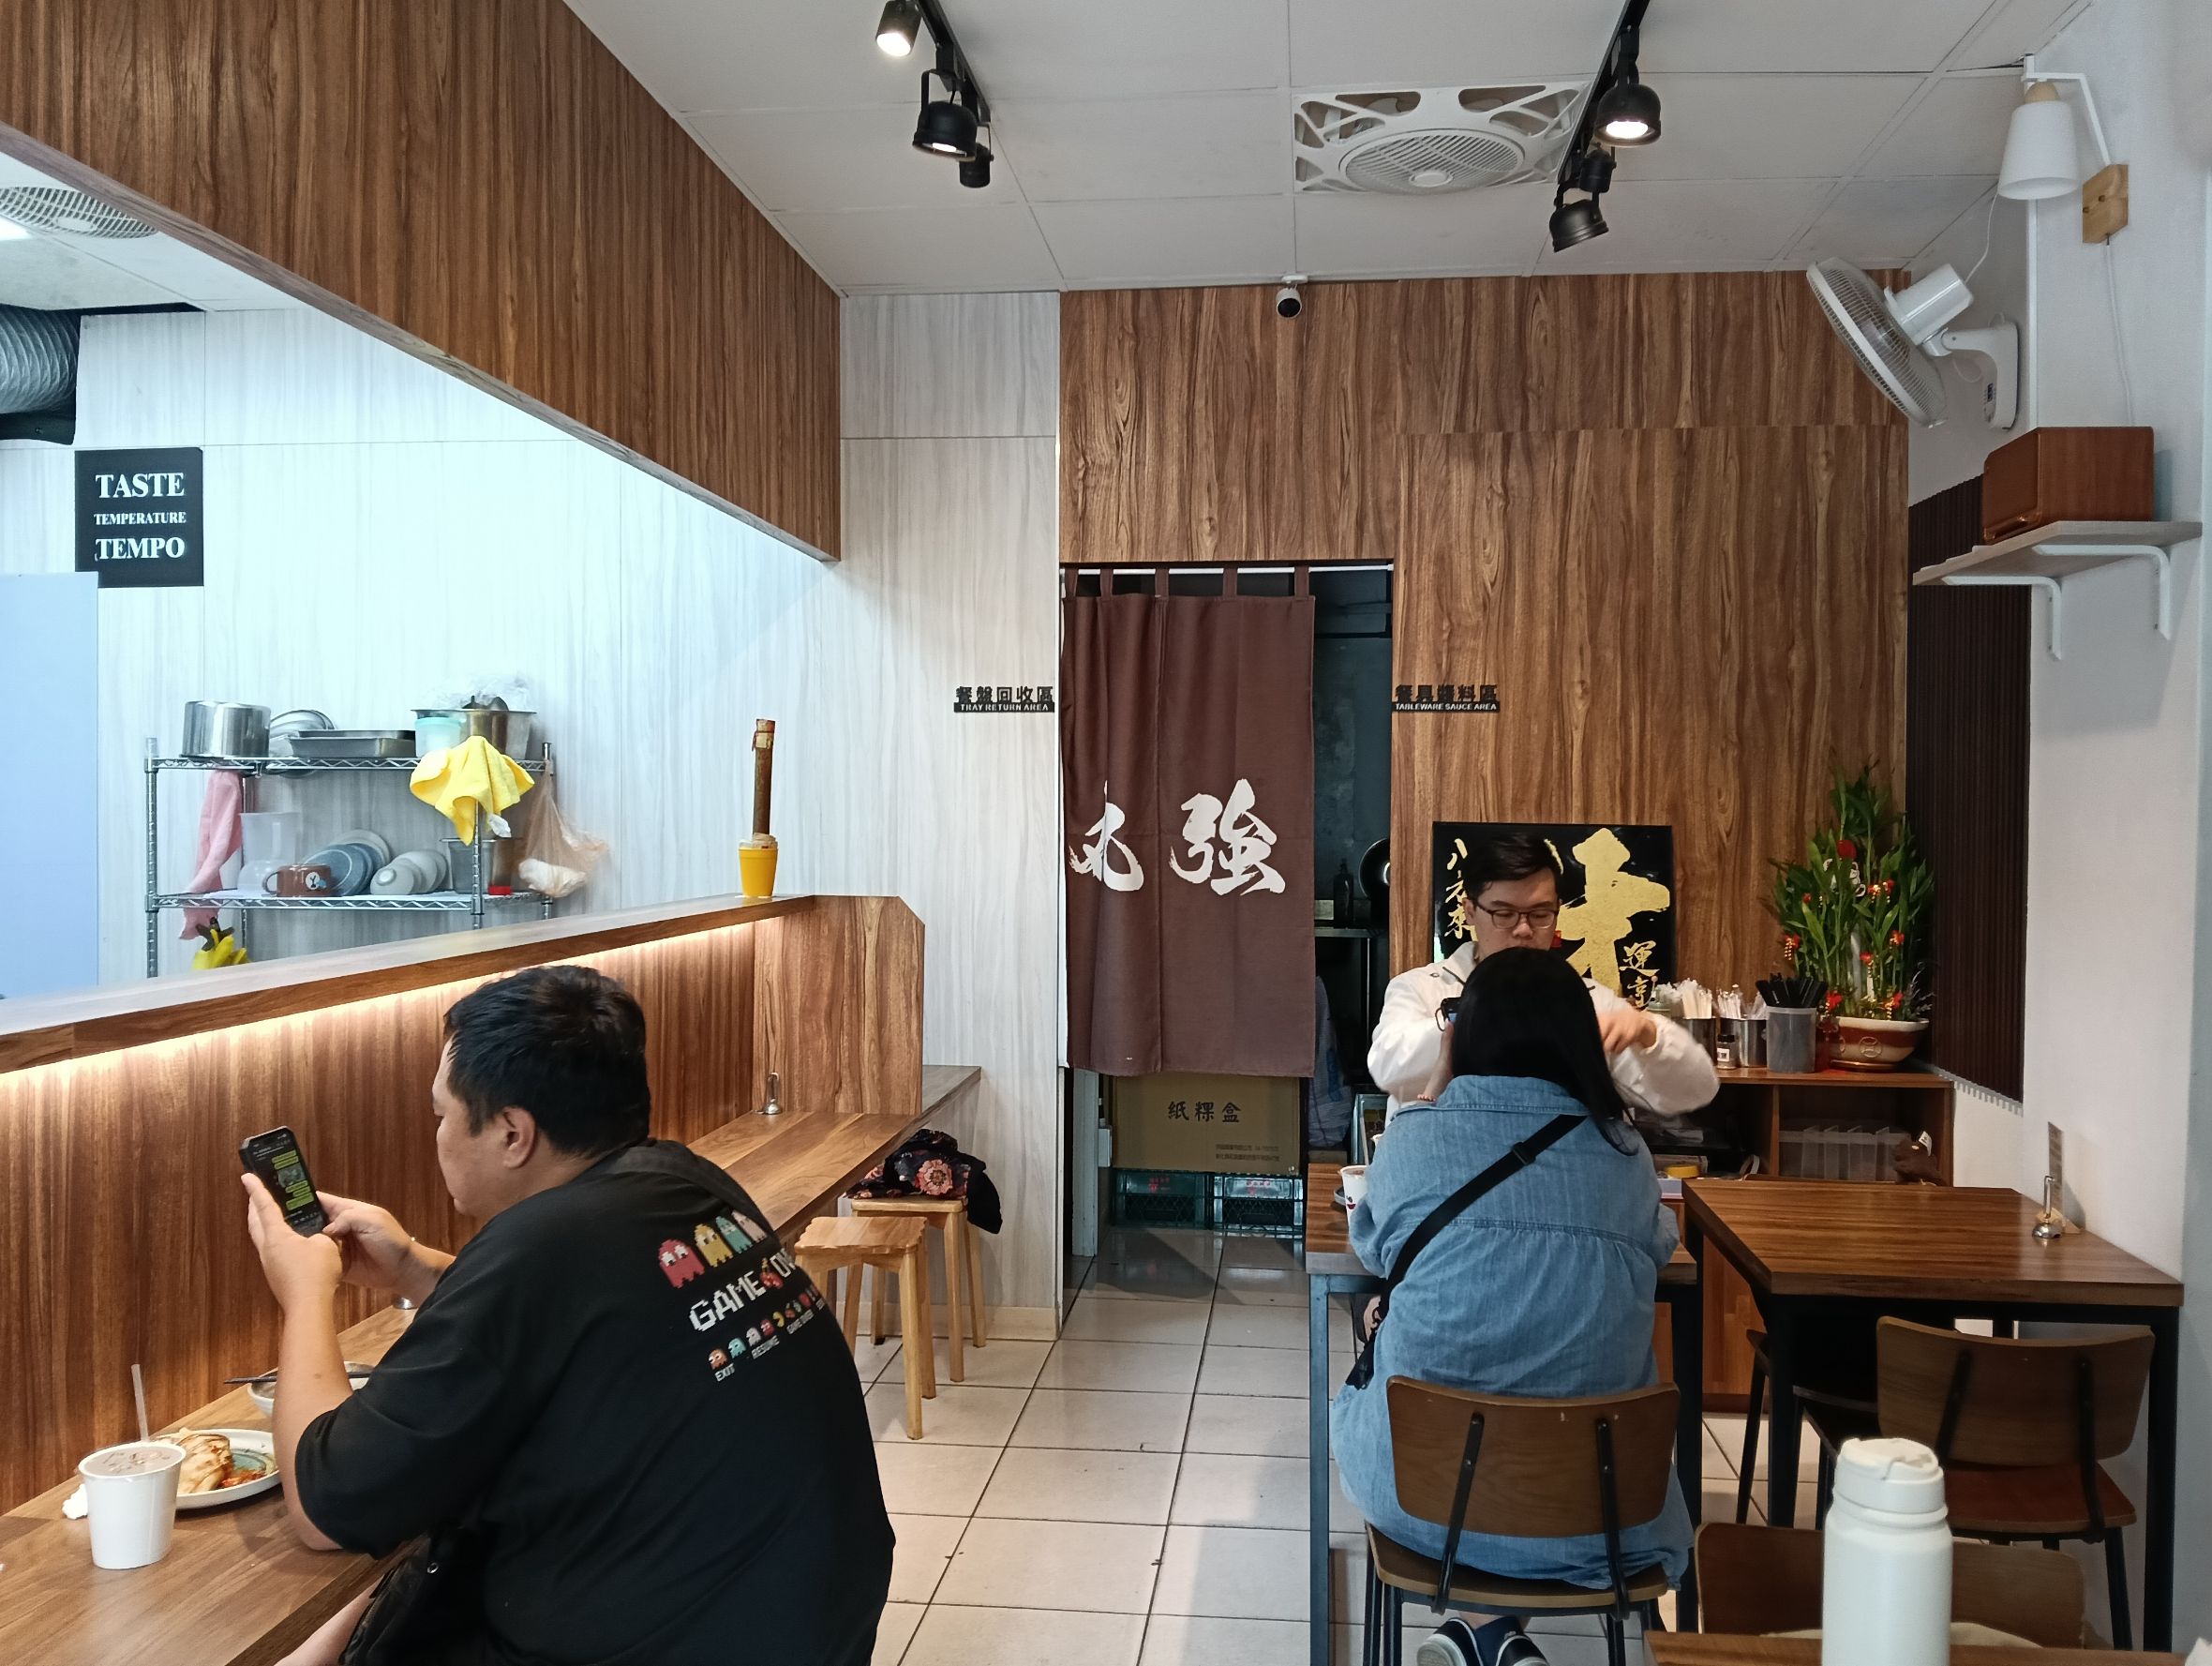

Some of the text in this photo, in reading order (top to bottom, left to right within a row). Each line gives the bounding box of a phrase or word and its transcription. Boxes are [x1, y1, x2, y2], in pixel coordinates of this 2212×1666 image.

[95, 472, 185, 499] TASTE
[94, 511, 187, 525] TEMPERATURE
[95, 536, 186, 560] TEMPO
[961, 703, 1049, 712] TRAY RETURN AREA
[1395, 702, 1497, 711] TABLEWARE SAUCE AREA
[1168, 1101, 1241, 1123] 紙粿盒
[689, 1270, 767, 1331] GAME
[714, 1362, 736, 1382] EXIT
[751, 1334, 780, 1359] RESUME
